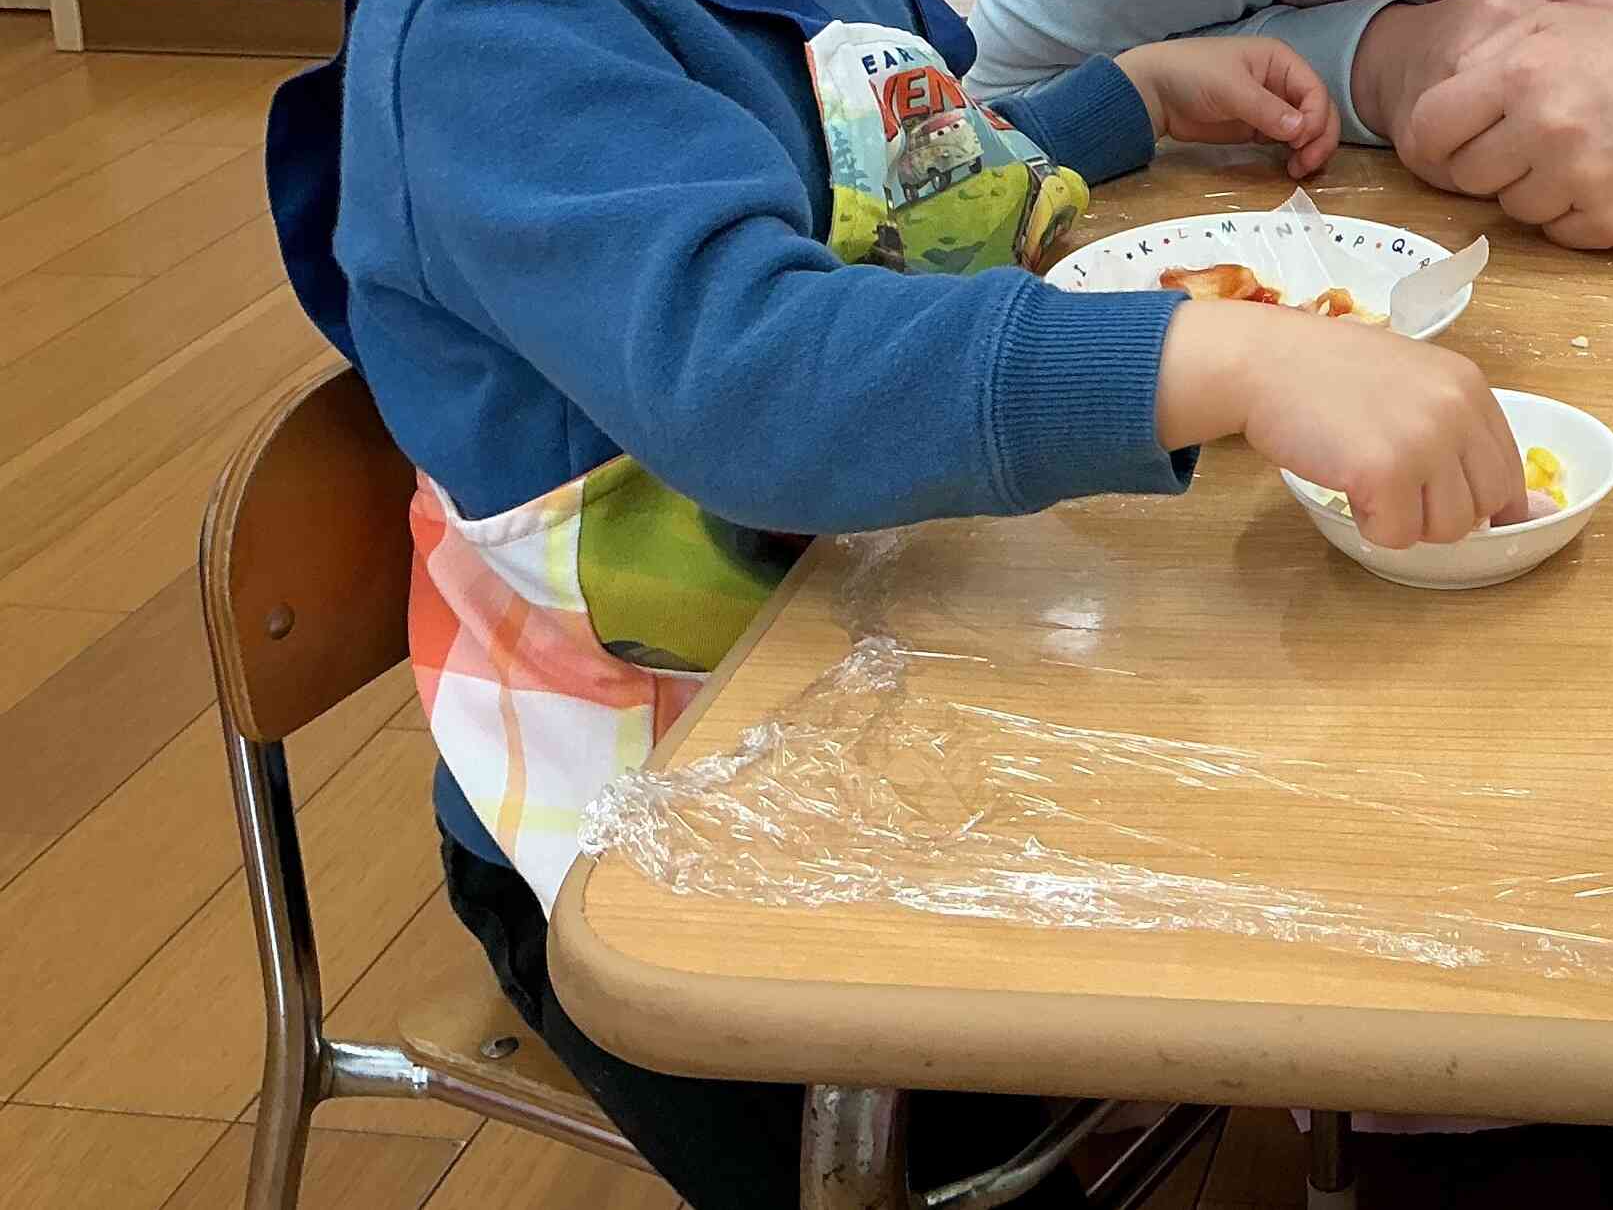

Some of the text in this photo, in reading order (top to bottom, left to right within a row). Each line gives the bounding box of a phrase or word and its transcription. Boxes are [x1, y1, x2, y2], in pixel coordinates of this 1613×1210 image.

[1137, 240, 1154, 256] K
[1220, 220, 1237, 234] M
[1352, 234, 1366, 249] P
[1391, 238, 1406, 255] Q
